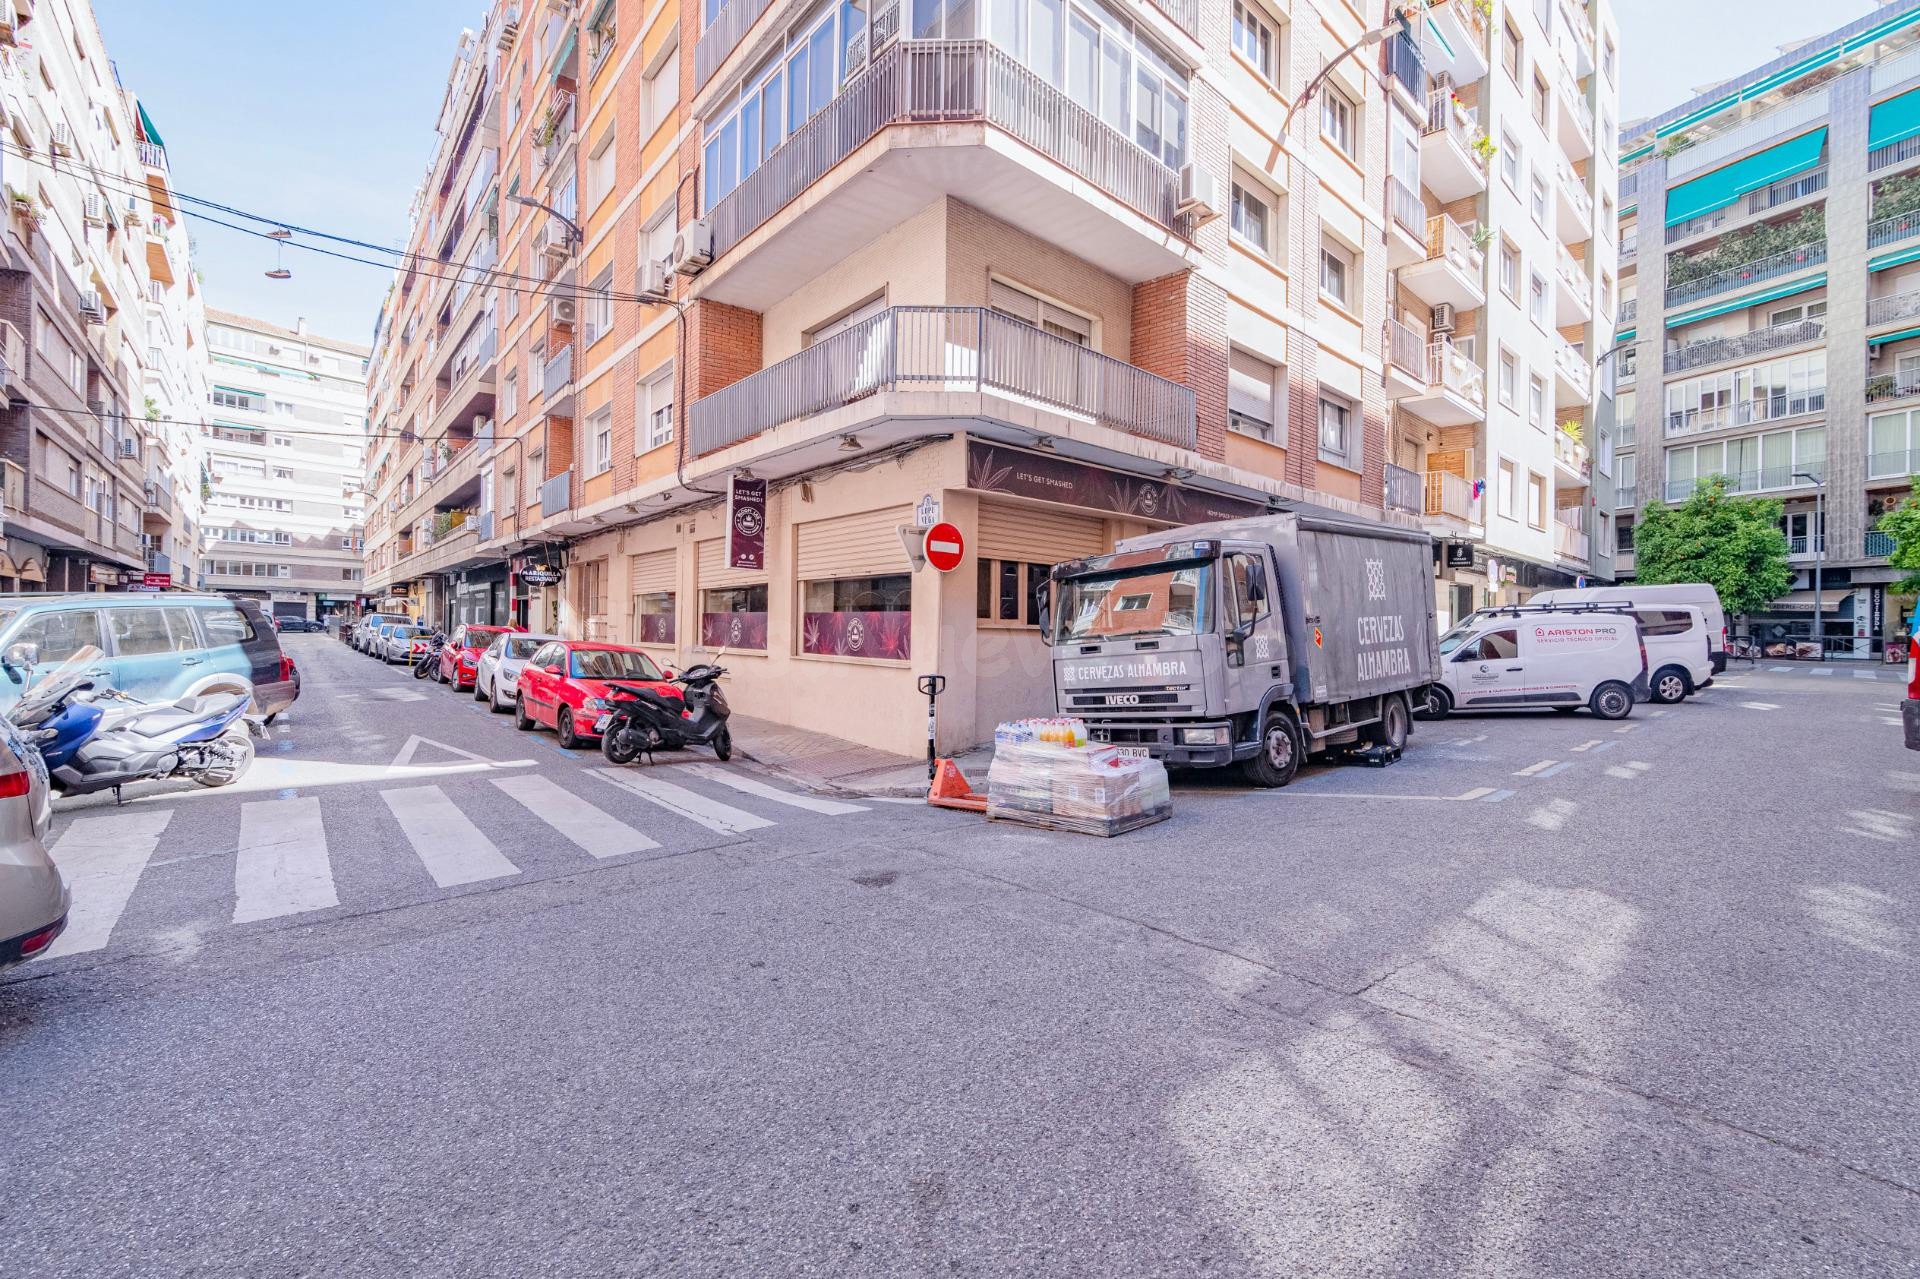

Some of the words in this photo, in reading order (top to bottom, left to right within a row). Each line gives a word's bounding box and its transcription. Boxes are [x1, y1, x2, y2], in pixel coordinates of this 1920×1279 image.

[1016, 472, 1033, 482] LET'S
[1033, 475, 1045, 484] GET
[1046, 478, 1073, 489] SMASHED
[1357, 615, 1405, 646] CERVEZAS
[1547, 628, 1594, 636] ARISTON
[1595, 627, 1617, 635] PRO
[1078, 665, 1124, 681] CERVEZAS
[1127, 661, 1187, 678] ALHAMBRA
[1357, 647, 1411, 681] ALHAMBRA
[1105, 694, 1140, 705] IVECO
[1132, 748, 1148, 757] BVC
